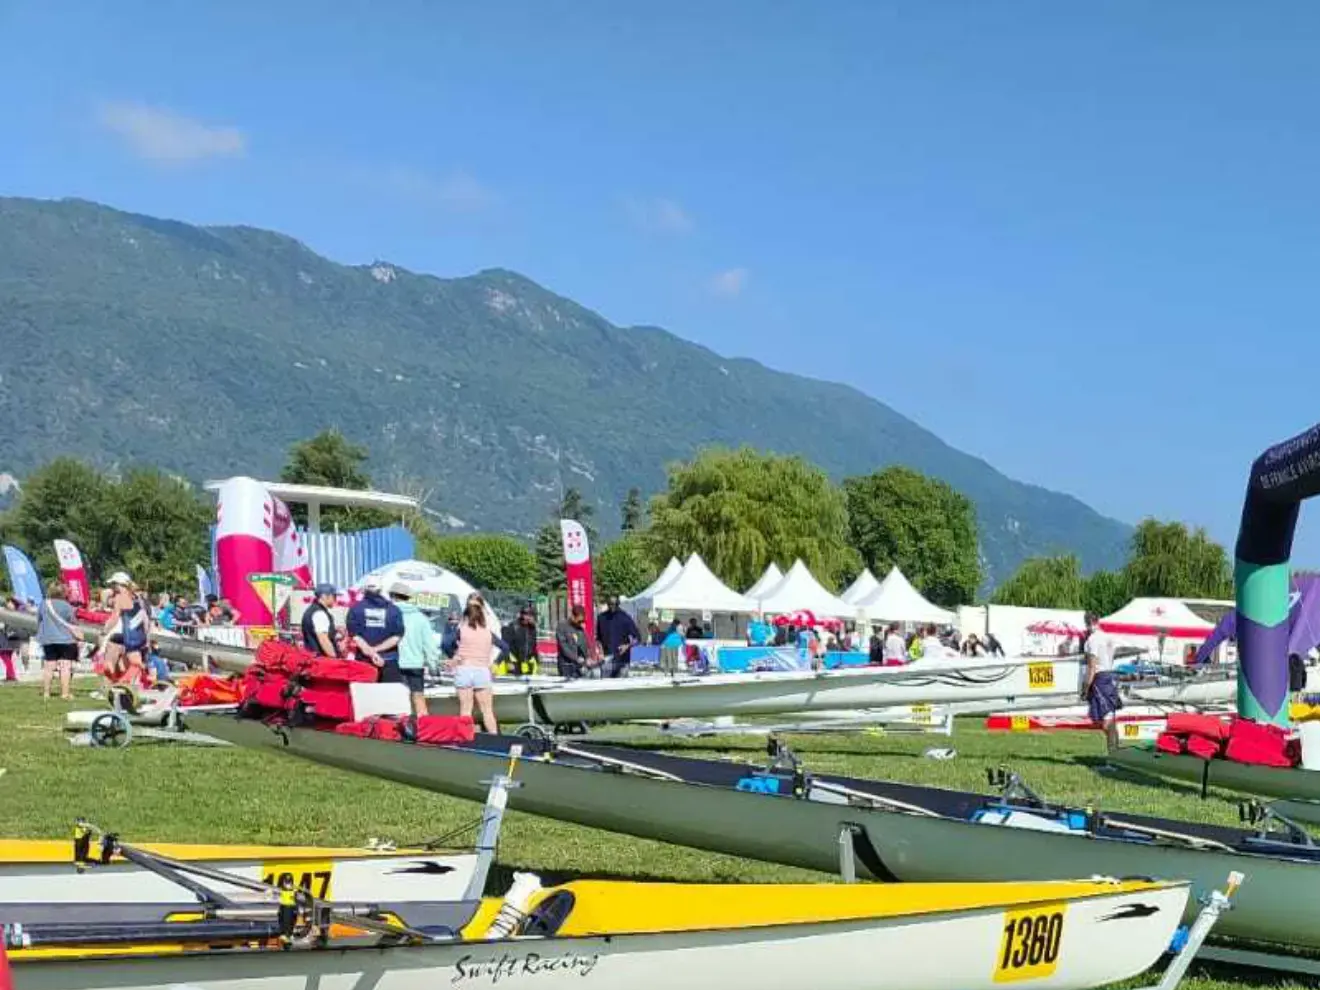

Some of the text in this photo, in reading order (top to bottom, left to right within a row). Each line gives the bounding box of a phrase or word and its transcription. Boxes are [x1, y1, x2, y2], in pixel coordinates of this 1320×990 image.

[1002, 912, 1063, 969] 1360
[451, 952, 599, 984] Swift Racing
